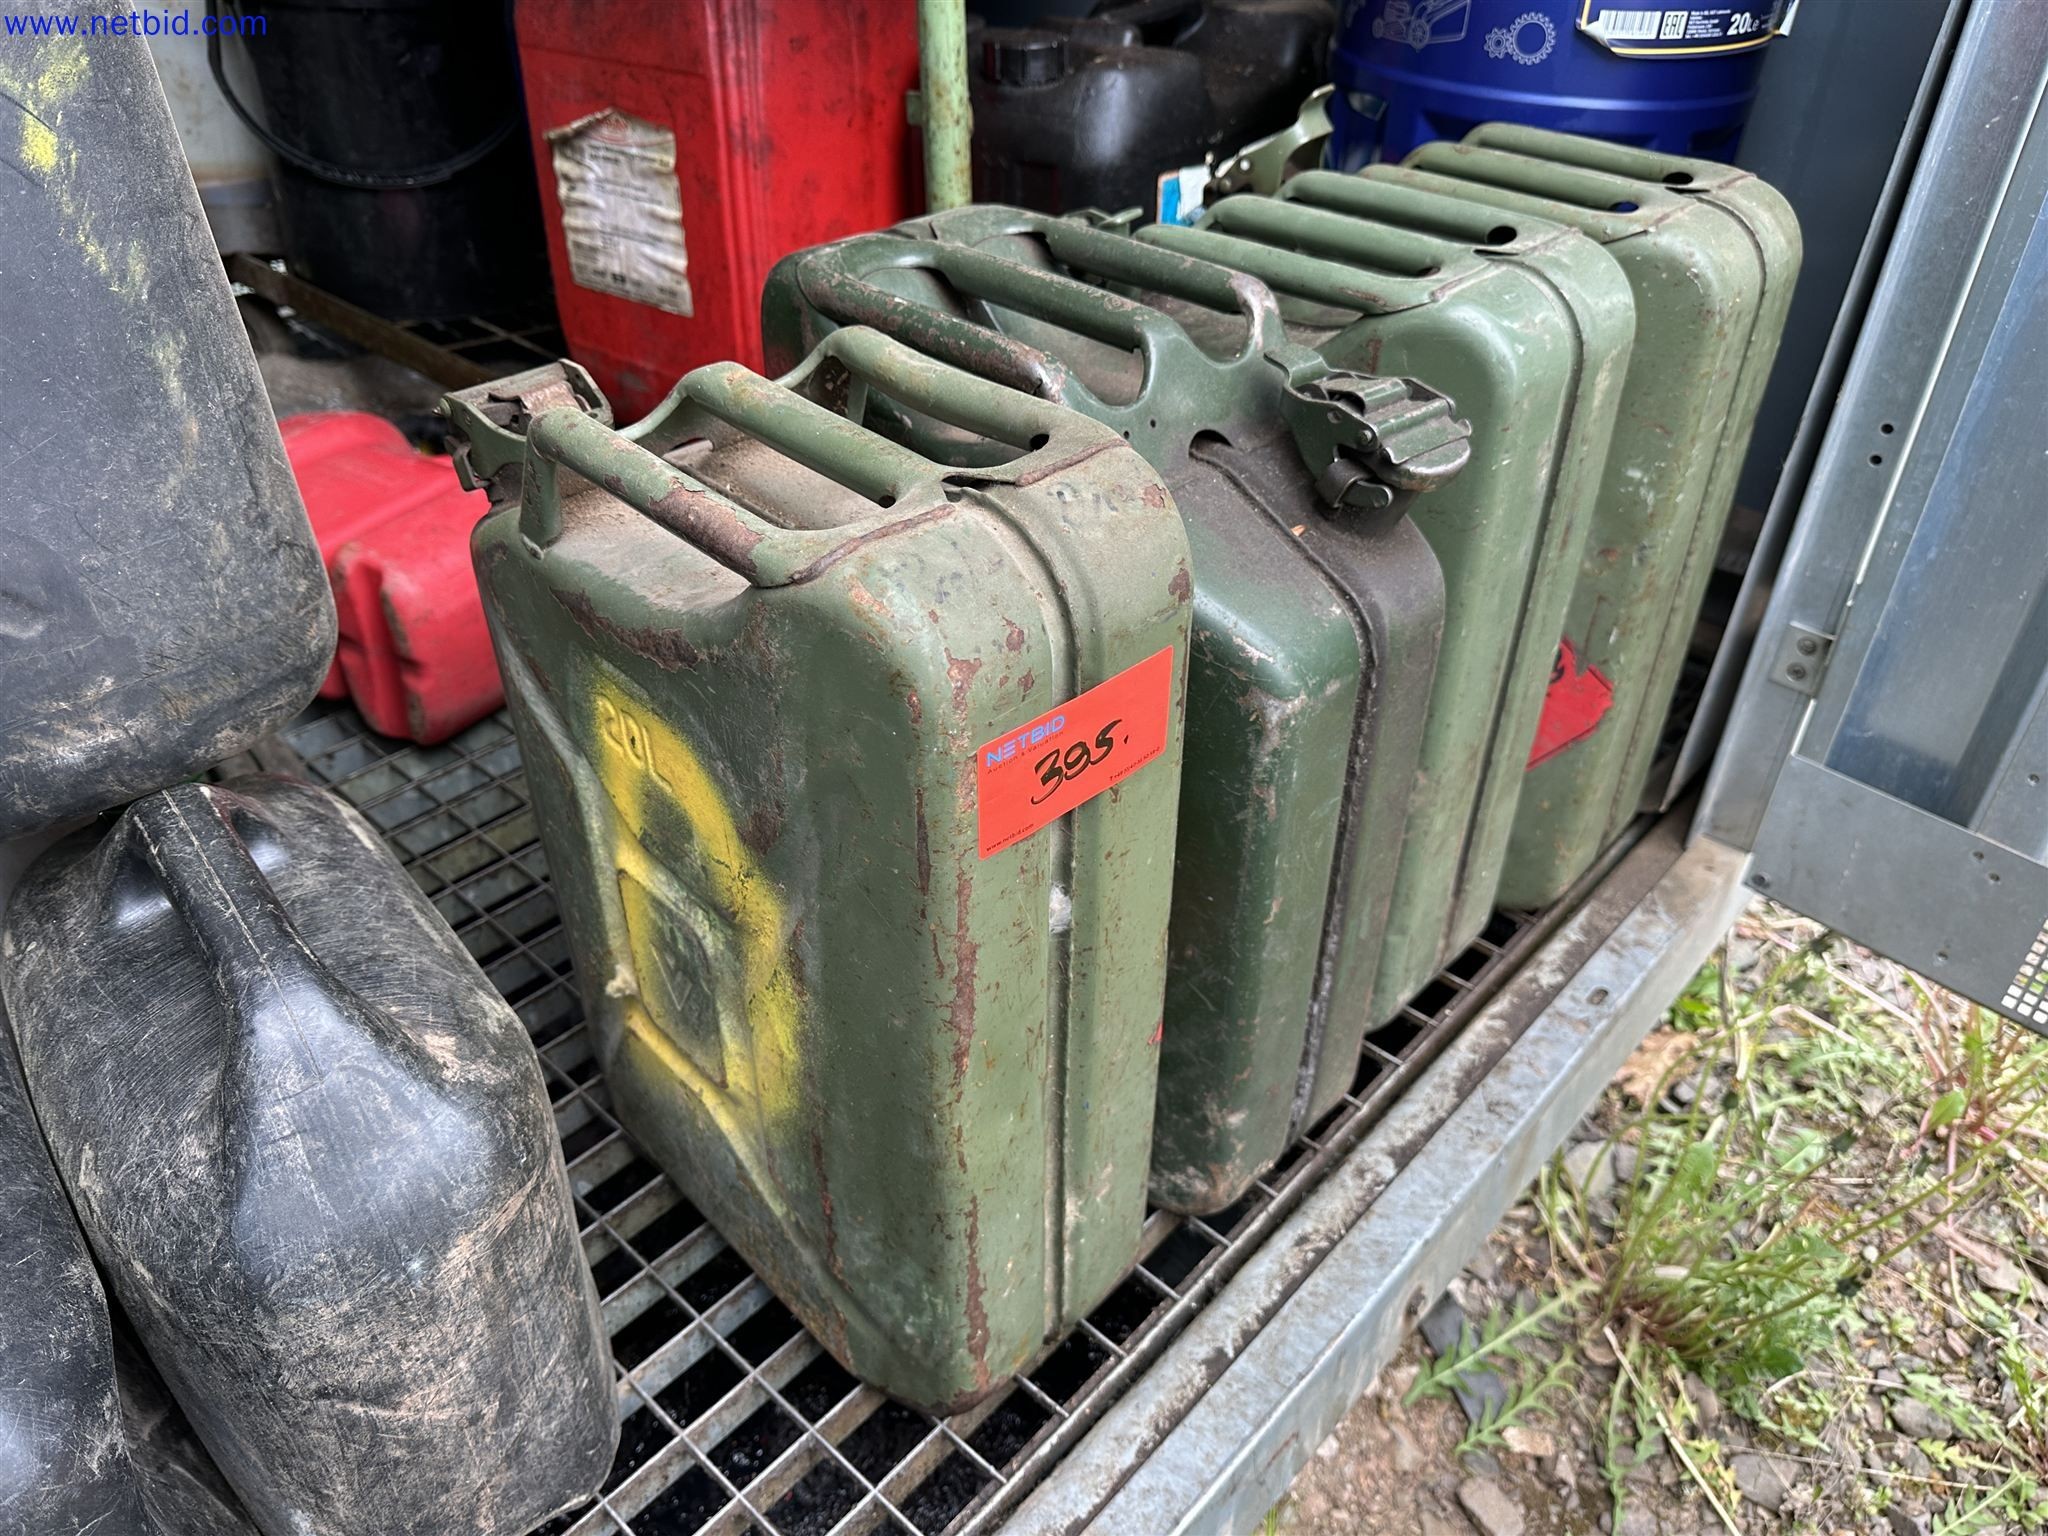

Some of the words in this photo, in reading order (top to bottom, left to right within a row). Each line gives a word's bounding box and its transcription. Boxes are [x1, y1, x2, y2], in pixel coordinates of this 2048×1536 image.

[985, 714, 1066, 768] NETBID
[986, 755, 1018, 774] Auction
[1028, 731, 1064, 753] Valuation
[986, 823, 1034, 852] www.netbid.com
